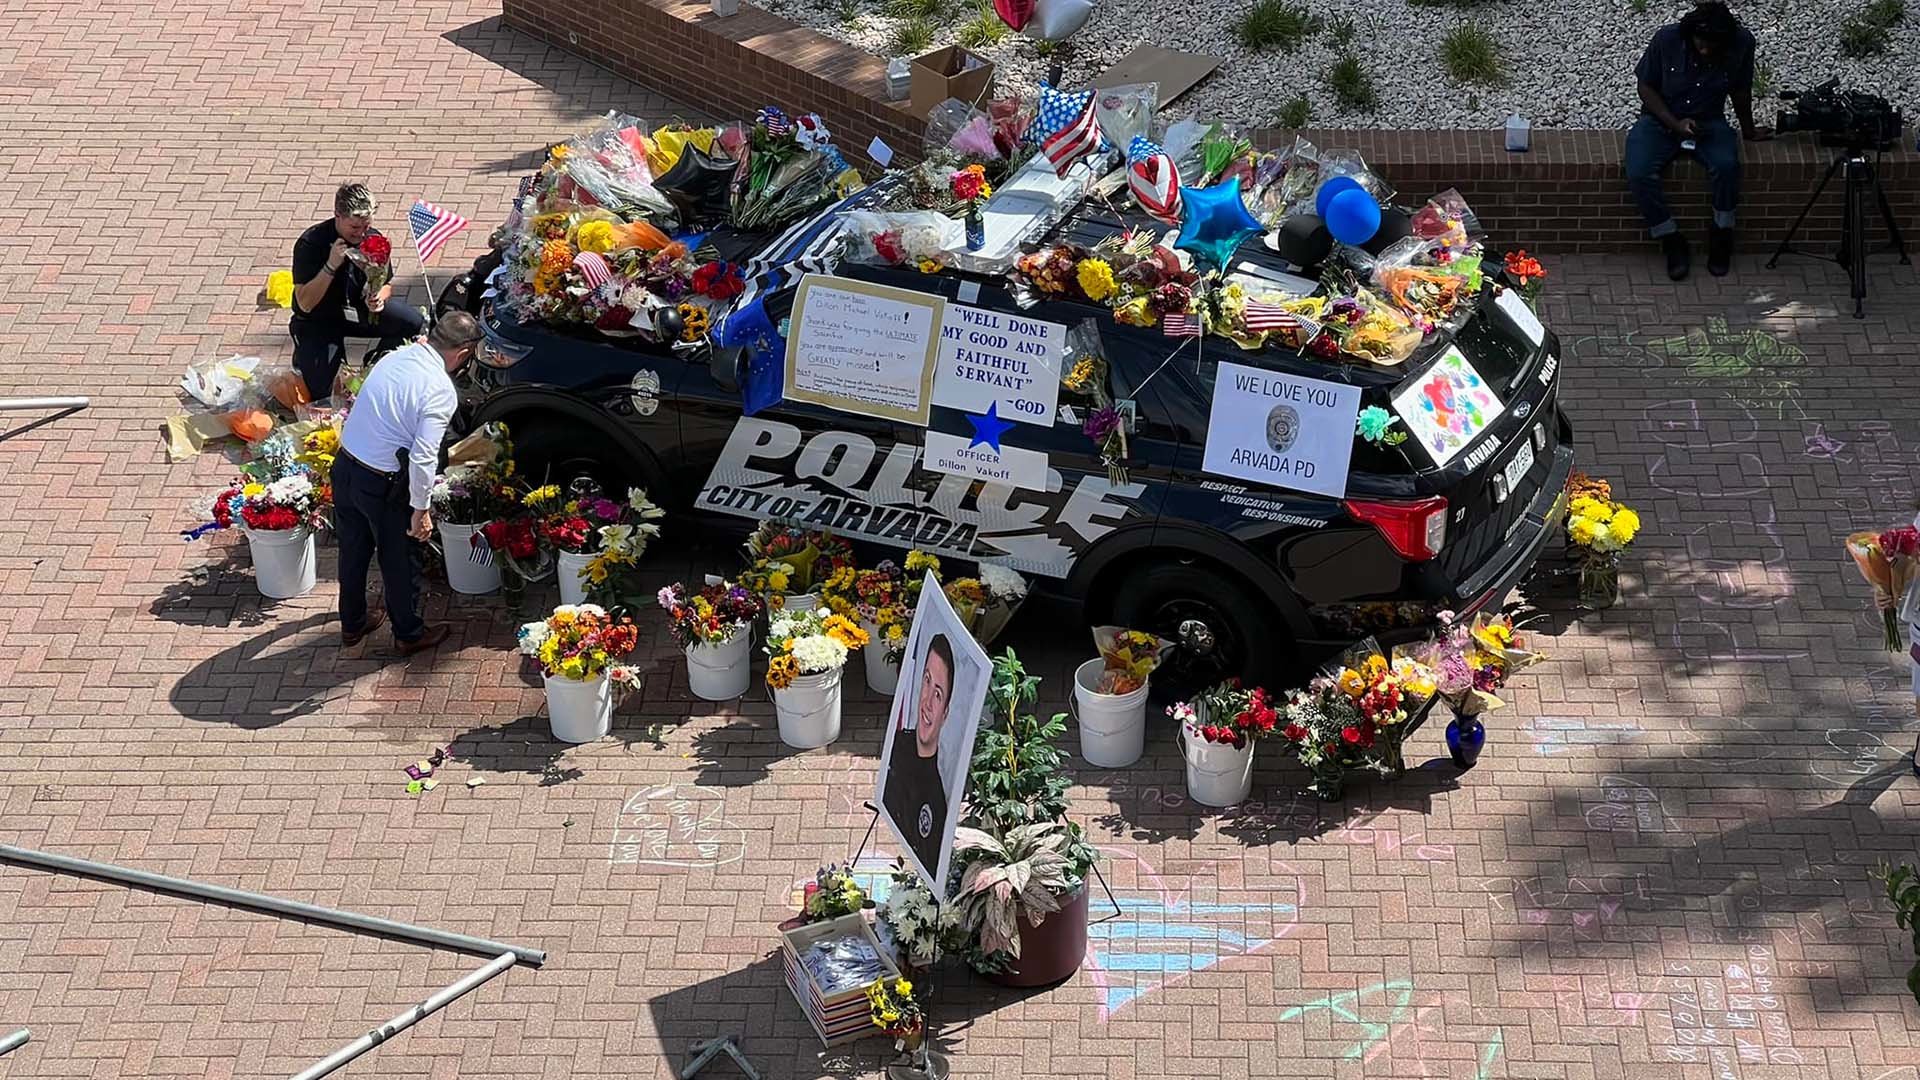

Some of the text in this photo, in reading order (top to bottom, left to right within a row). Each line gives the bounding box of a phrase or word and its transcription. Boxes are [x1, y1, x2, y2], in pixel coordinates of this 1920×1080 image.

[1008, 320, 1048, 338] DONE
[942, 326, 1046, 356] MY GOOD AND
[956, 348, 1029, 374] FAITHFUL
[1538, 353, 1558, 386] POLICE
[1236, 374, 1337, 408] WE LOVE YOU
[956, 449, 1000, 464] OFFICER
[1230, 448, 1315, 479] ARVADA PD
[1463, 434, 1502, 471] ARVADA
[938, 459, 1010, 480] Dillon Vakoff
[1200, 481, 1247, 495] RESPECT
[1220, 494, 1284, 511] DEDICATION
[707, 485, 982, 555] CITY OF ARVADA
[1242, 508, 1328, 529] RESPONSIBILITY
[1455, 506, 1466, 523] 27
